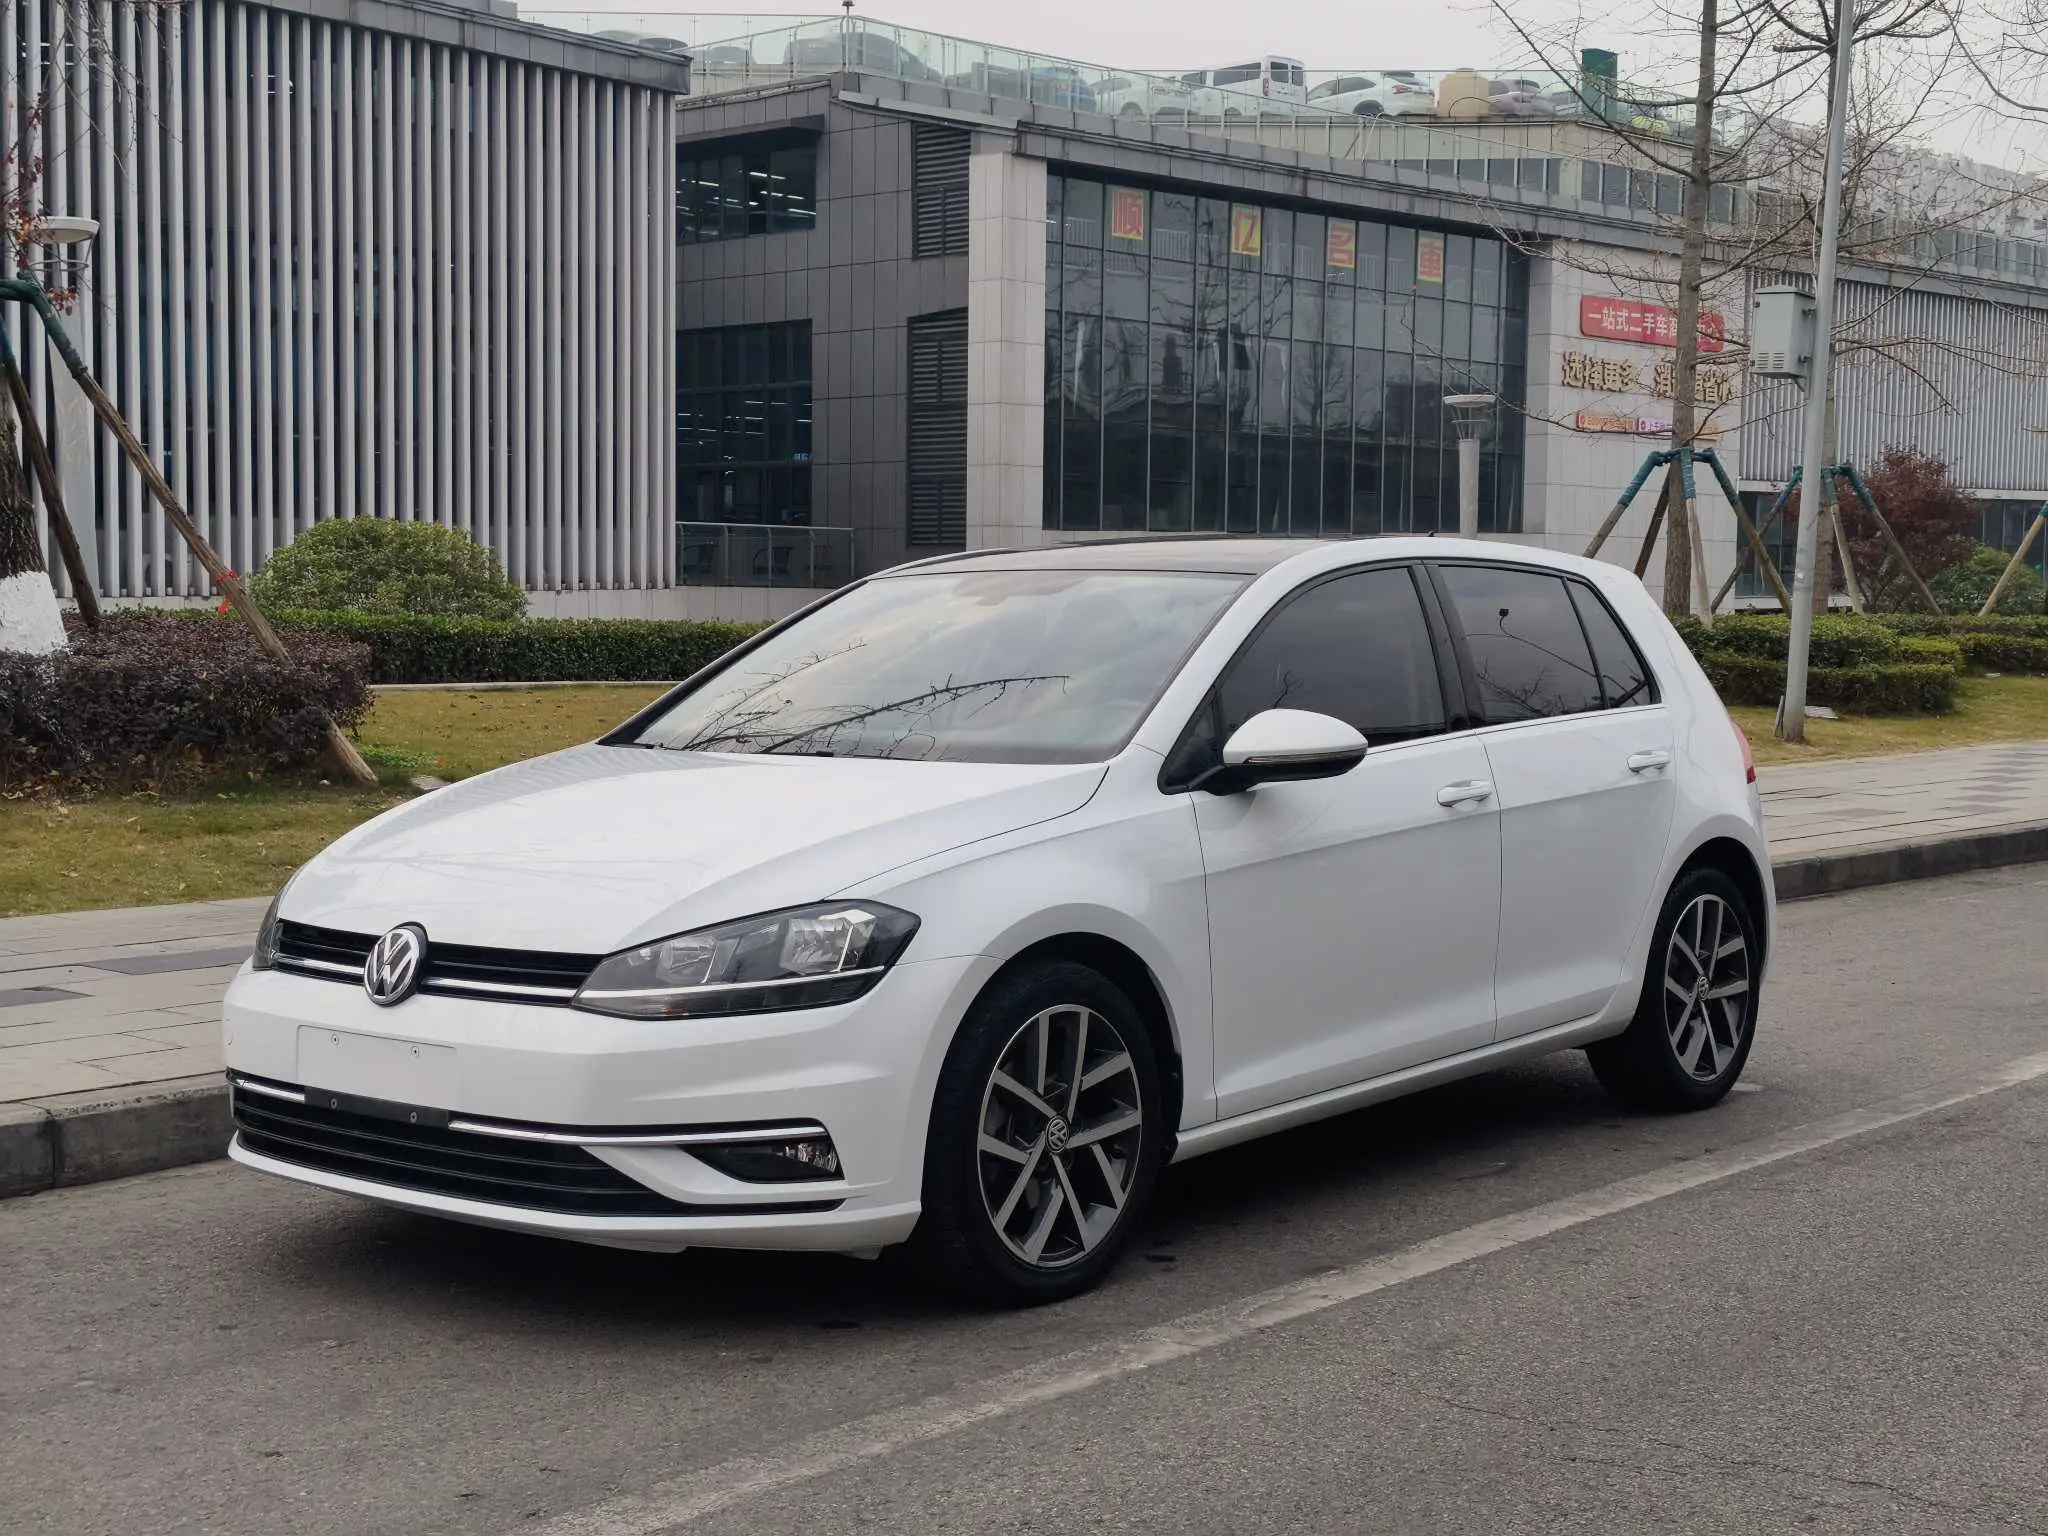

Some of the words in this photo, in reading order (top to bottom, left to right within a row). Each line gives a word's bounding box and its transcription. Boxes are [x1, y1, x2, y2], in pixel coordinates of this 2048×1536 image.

[1587, 306, 1720, 344] 一站式二手车商中心
[1655, 361, 1733, 403] 消省心
[365, 928, 420, 1005] VW
